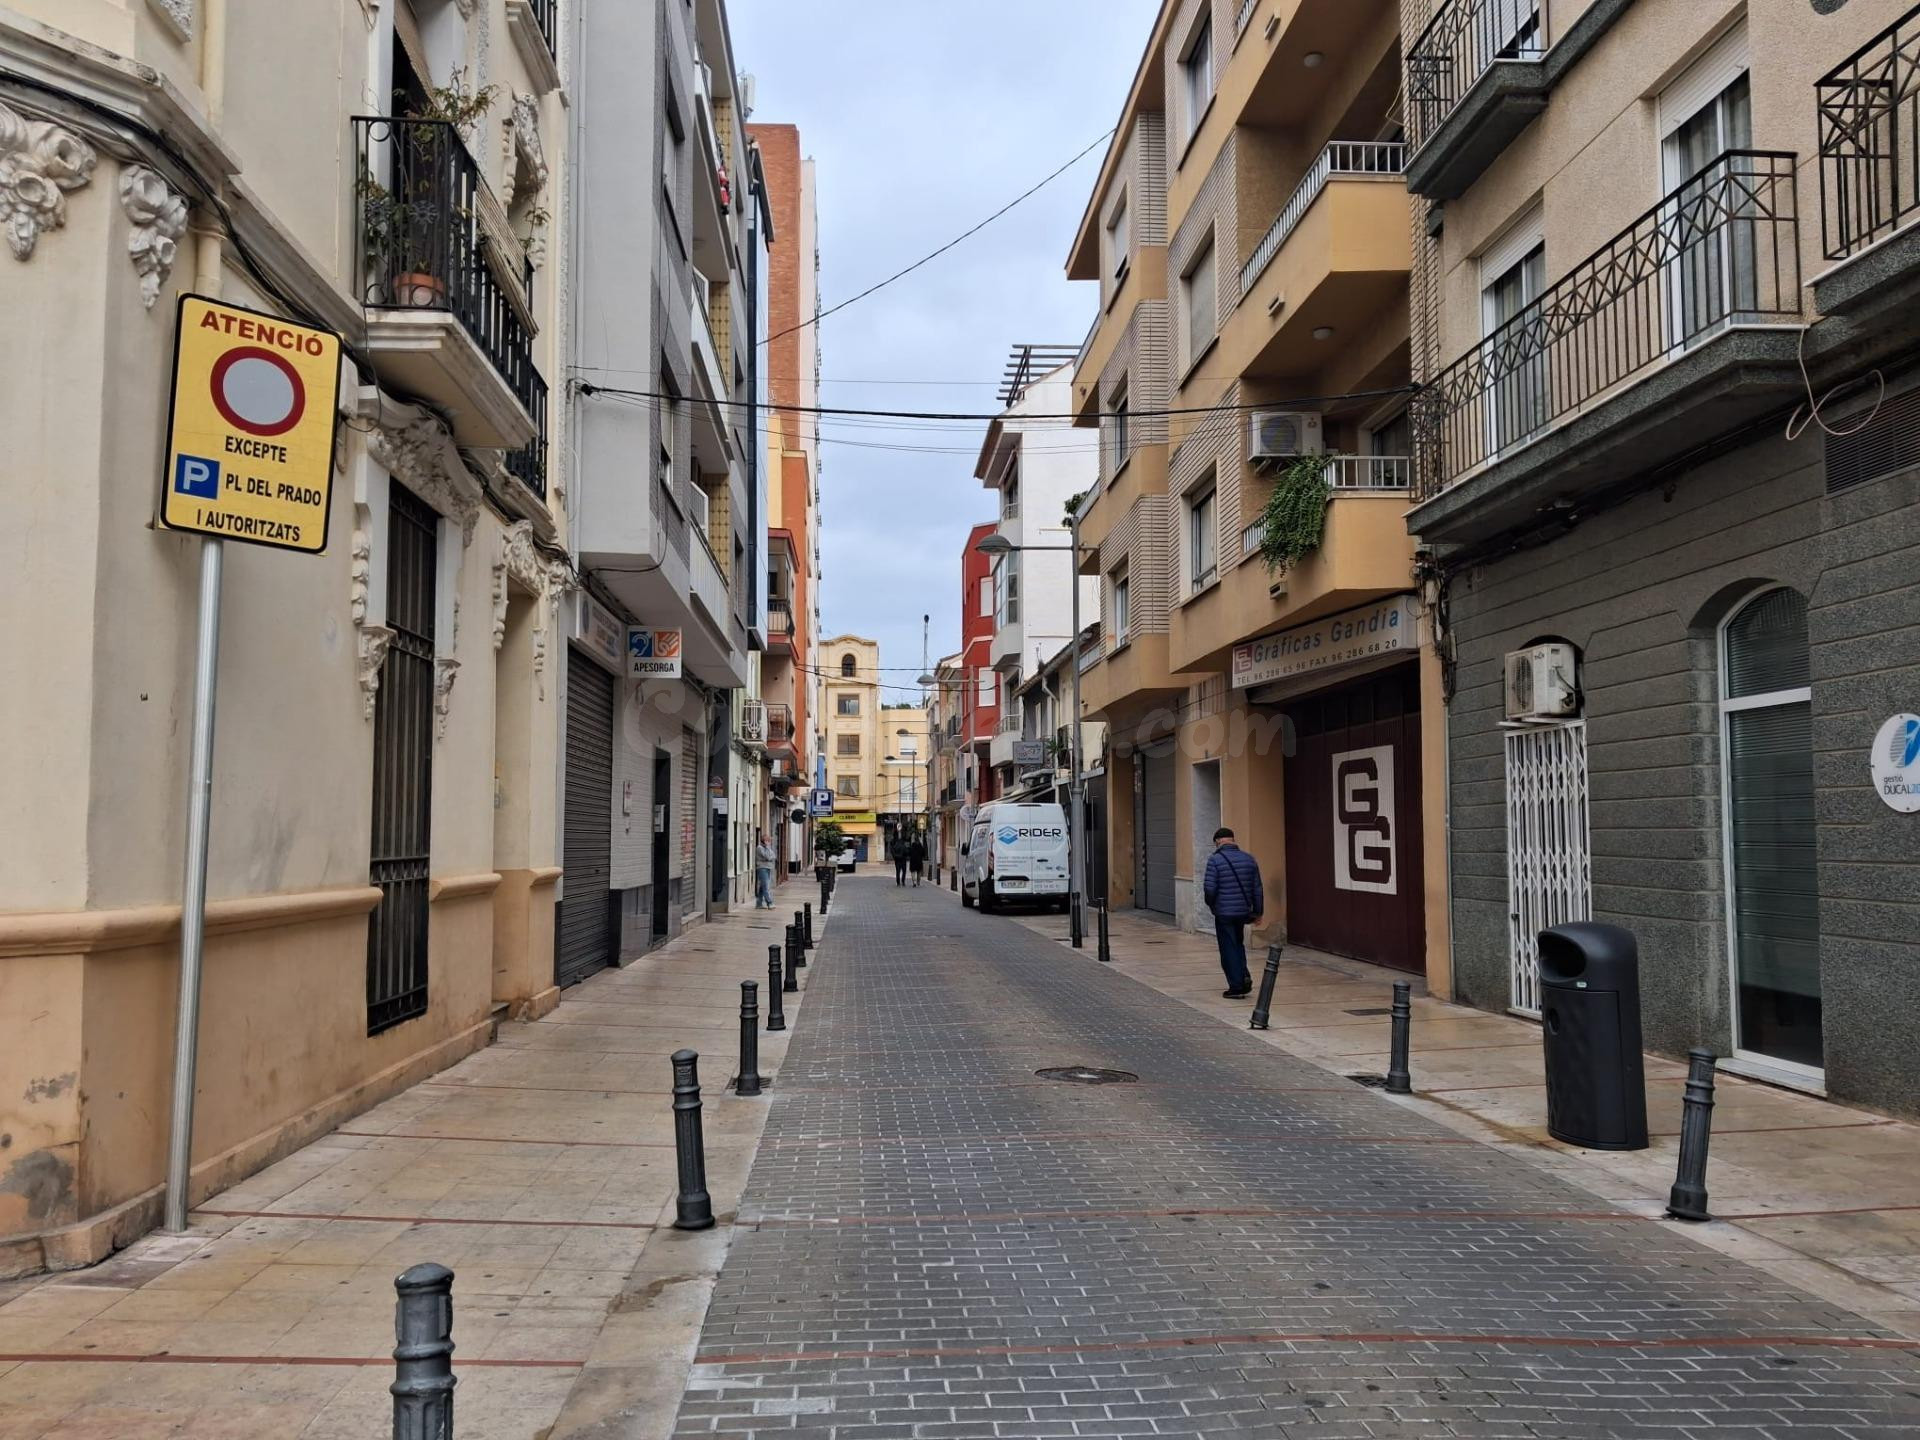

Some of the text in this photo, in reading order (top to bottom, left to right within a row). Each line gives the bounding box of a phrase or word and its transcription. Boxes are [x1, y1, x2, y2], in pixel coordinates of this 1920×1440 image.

[200, 310, 323, 356] ATENCIÓ
[224, 435, 287, 463] EXCEPTE
[225, 473, 322, 506] PL DEL PRADO
[196, 508, 300, 542] I AUTORITZATS
[1254, 632, 1321, 663] Gráficas
[1331, 607, 1399, 642] Gandia
[634, 662, 675, 673] APESORGA
[1310, 656, 1328, 668] FAX
[1385, 638, 1397, 649] 20
[1018, 827, 1062, 838] RIDER
